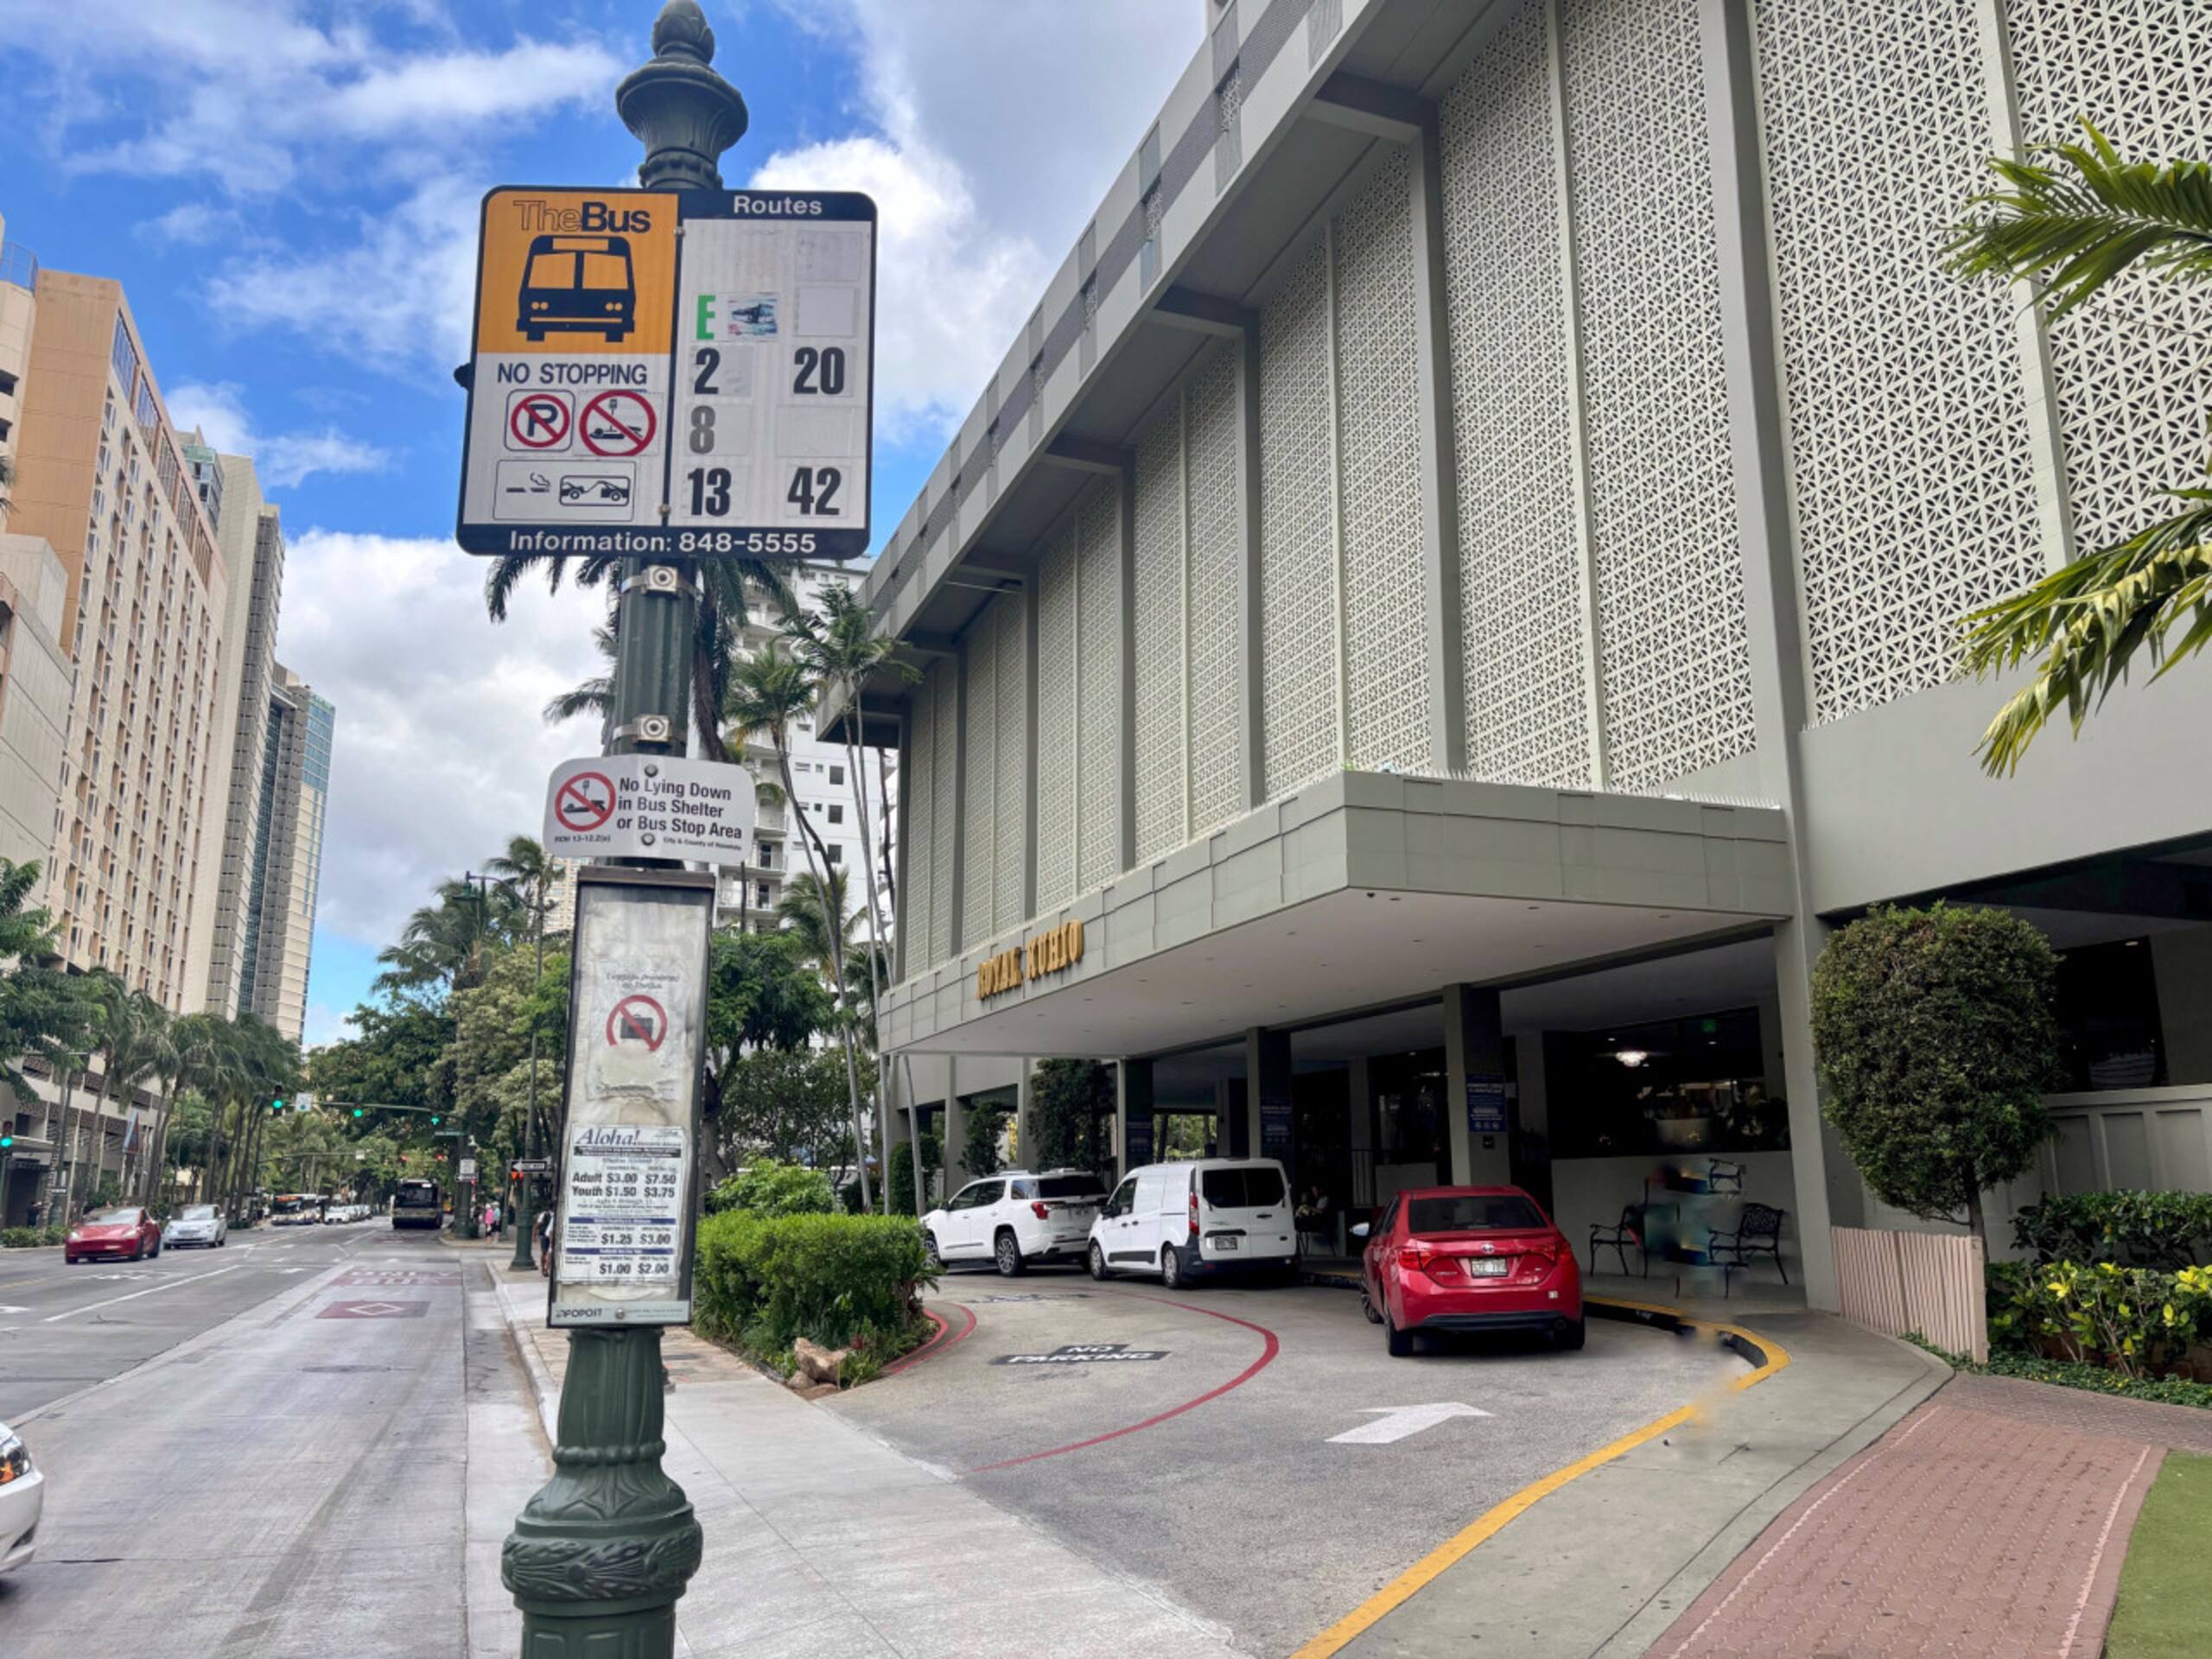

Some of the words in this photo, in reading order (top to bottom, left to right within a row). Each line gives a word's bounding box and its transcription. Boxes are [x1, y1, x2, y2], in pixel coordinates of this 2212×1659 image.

[513, 200, 651, 233] TheBus
[734, 195, 823, 215] Routes
[696, 295, 716, 340] E
[498, 363, 531, 384] NO
[539, 363, 648, 385] STOPPING
[694, 347, 721, 394] 2
[793, 346, 846, 395] 20
[690, 405, 716, 454] 8
[688, 467, 732, 516] 13
[788, 467, 842, 516] 42
[510, 530, 672, 552] Information:
[678, 533, 817, 554] 848-5555
[619, 777, 639, 792] No
[644, 778, 685, 798] Lying
[690, 782, 732, 801] Down
[618, 797, 632, 810] in
[637, 798, 666, 812] Bus
[671, 799, 724, 818] Shelter
[616, 817, 632, 830] or
[637, 815, 667, 831] Bus
[671, 817, 706, 838] Stop
[709, 824, 742, 840] Area
[577, 1128, 641, 1146] Aloha!
[572, 1173, 602, 1183] Adult
[606, 1173, 638, 1184] $3.00
[645, 1173, 677, 1185] $7.50
[572, 1185, 602, 1197] Youth
[605, 1186, 637, 1198] $1.50
[644, 1186, 675, 1198] $3.75
[601, 1233, 632, 1245] $1.25
[639, 1234, 671, 1245] $3.00
[599, 1263, 632, 1274] $1.00
[638, 1263, 670, 1274] $2.00
